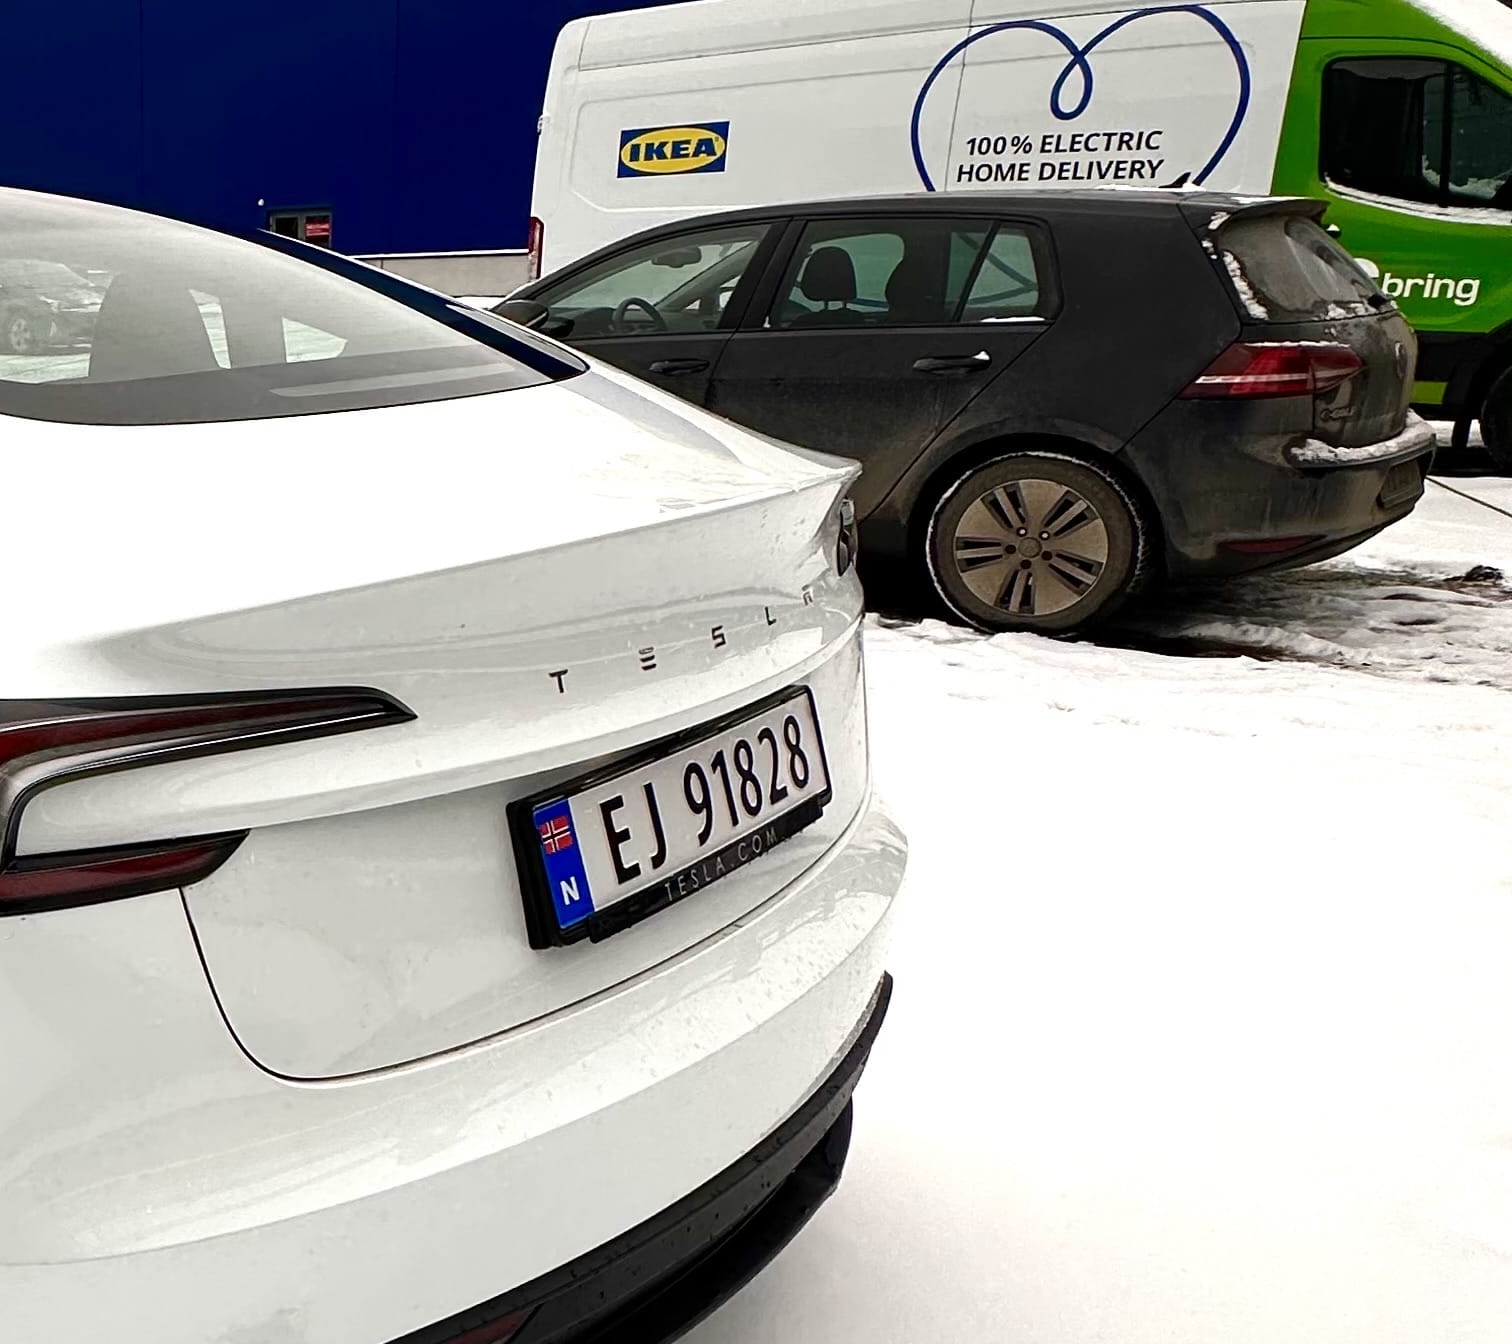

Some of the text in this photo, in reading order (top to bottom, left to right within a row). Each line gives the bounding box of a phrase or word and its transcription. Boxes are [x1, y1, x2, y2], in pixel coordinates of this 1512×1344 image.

[628, 137, 718, 163] IKEA
[1039, 130, 1164, 154] ELECTRIC
[956, 158, 1165, 183] HOME DELIVERY
[1381, 272, 1481, 306] bring
[548, 584, 814, 694] TESLA
[598, 714, 809, 885] EJ 91828
[664, 826, 778, 902] TESLA.COM
[559, 876, 581, 906] N
